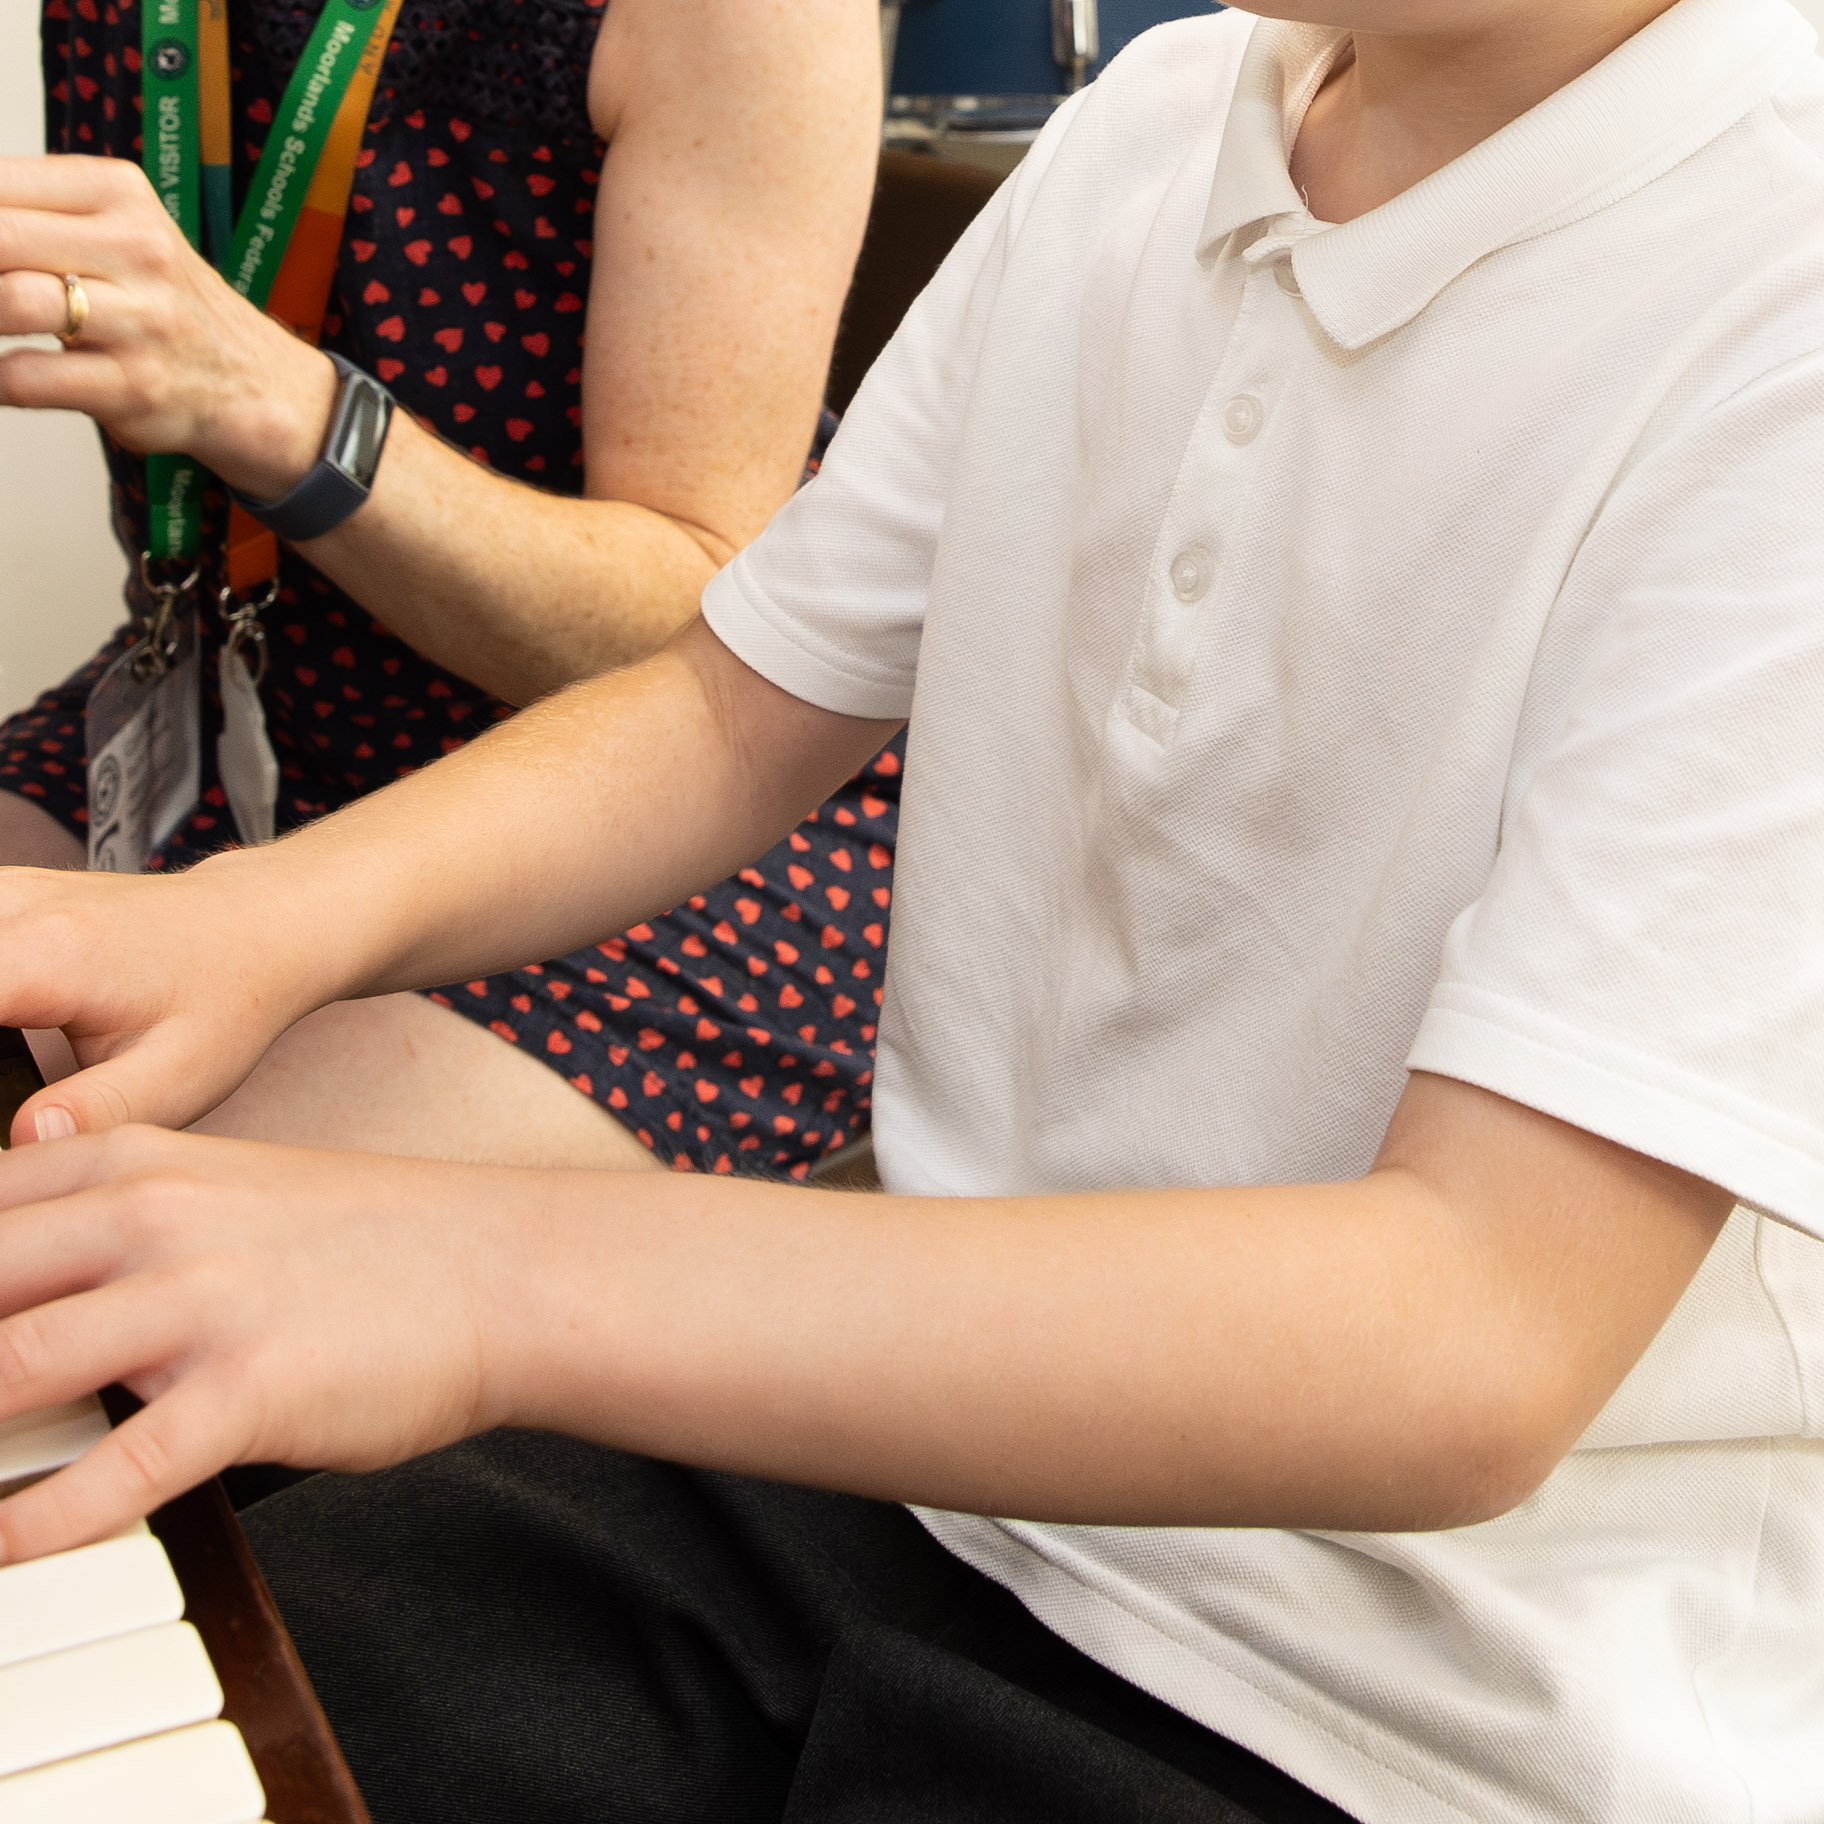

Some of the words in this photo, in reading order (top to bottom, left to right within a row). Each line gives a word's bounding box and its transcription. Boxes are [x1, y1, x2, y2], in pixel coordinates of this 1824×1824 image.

[292, 19, 356, 134] Moorlands
[158, 95, 181, 189] VISITOR
[260, 135, 306, 221] Schools
[234, 222, 275, 298] Federa
